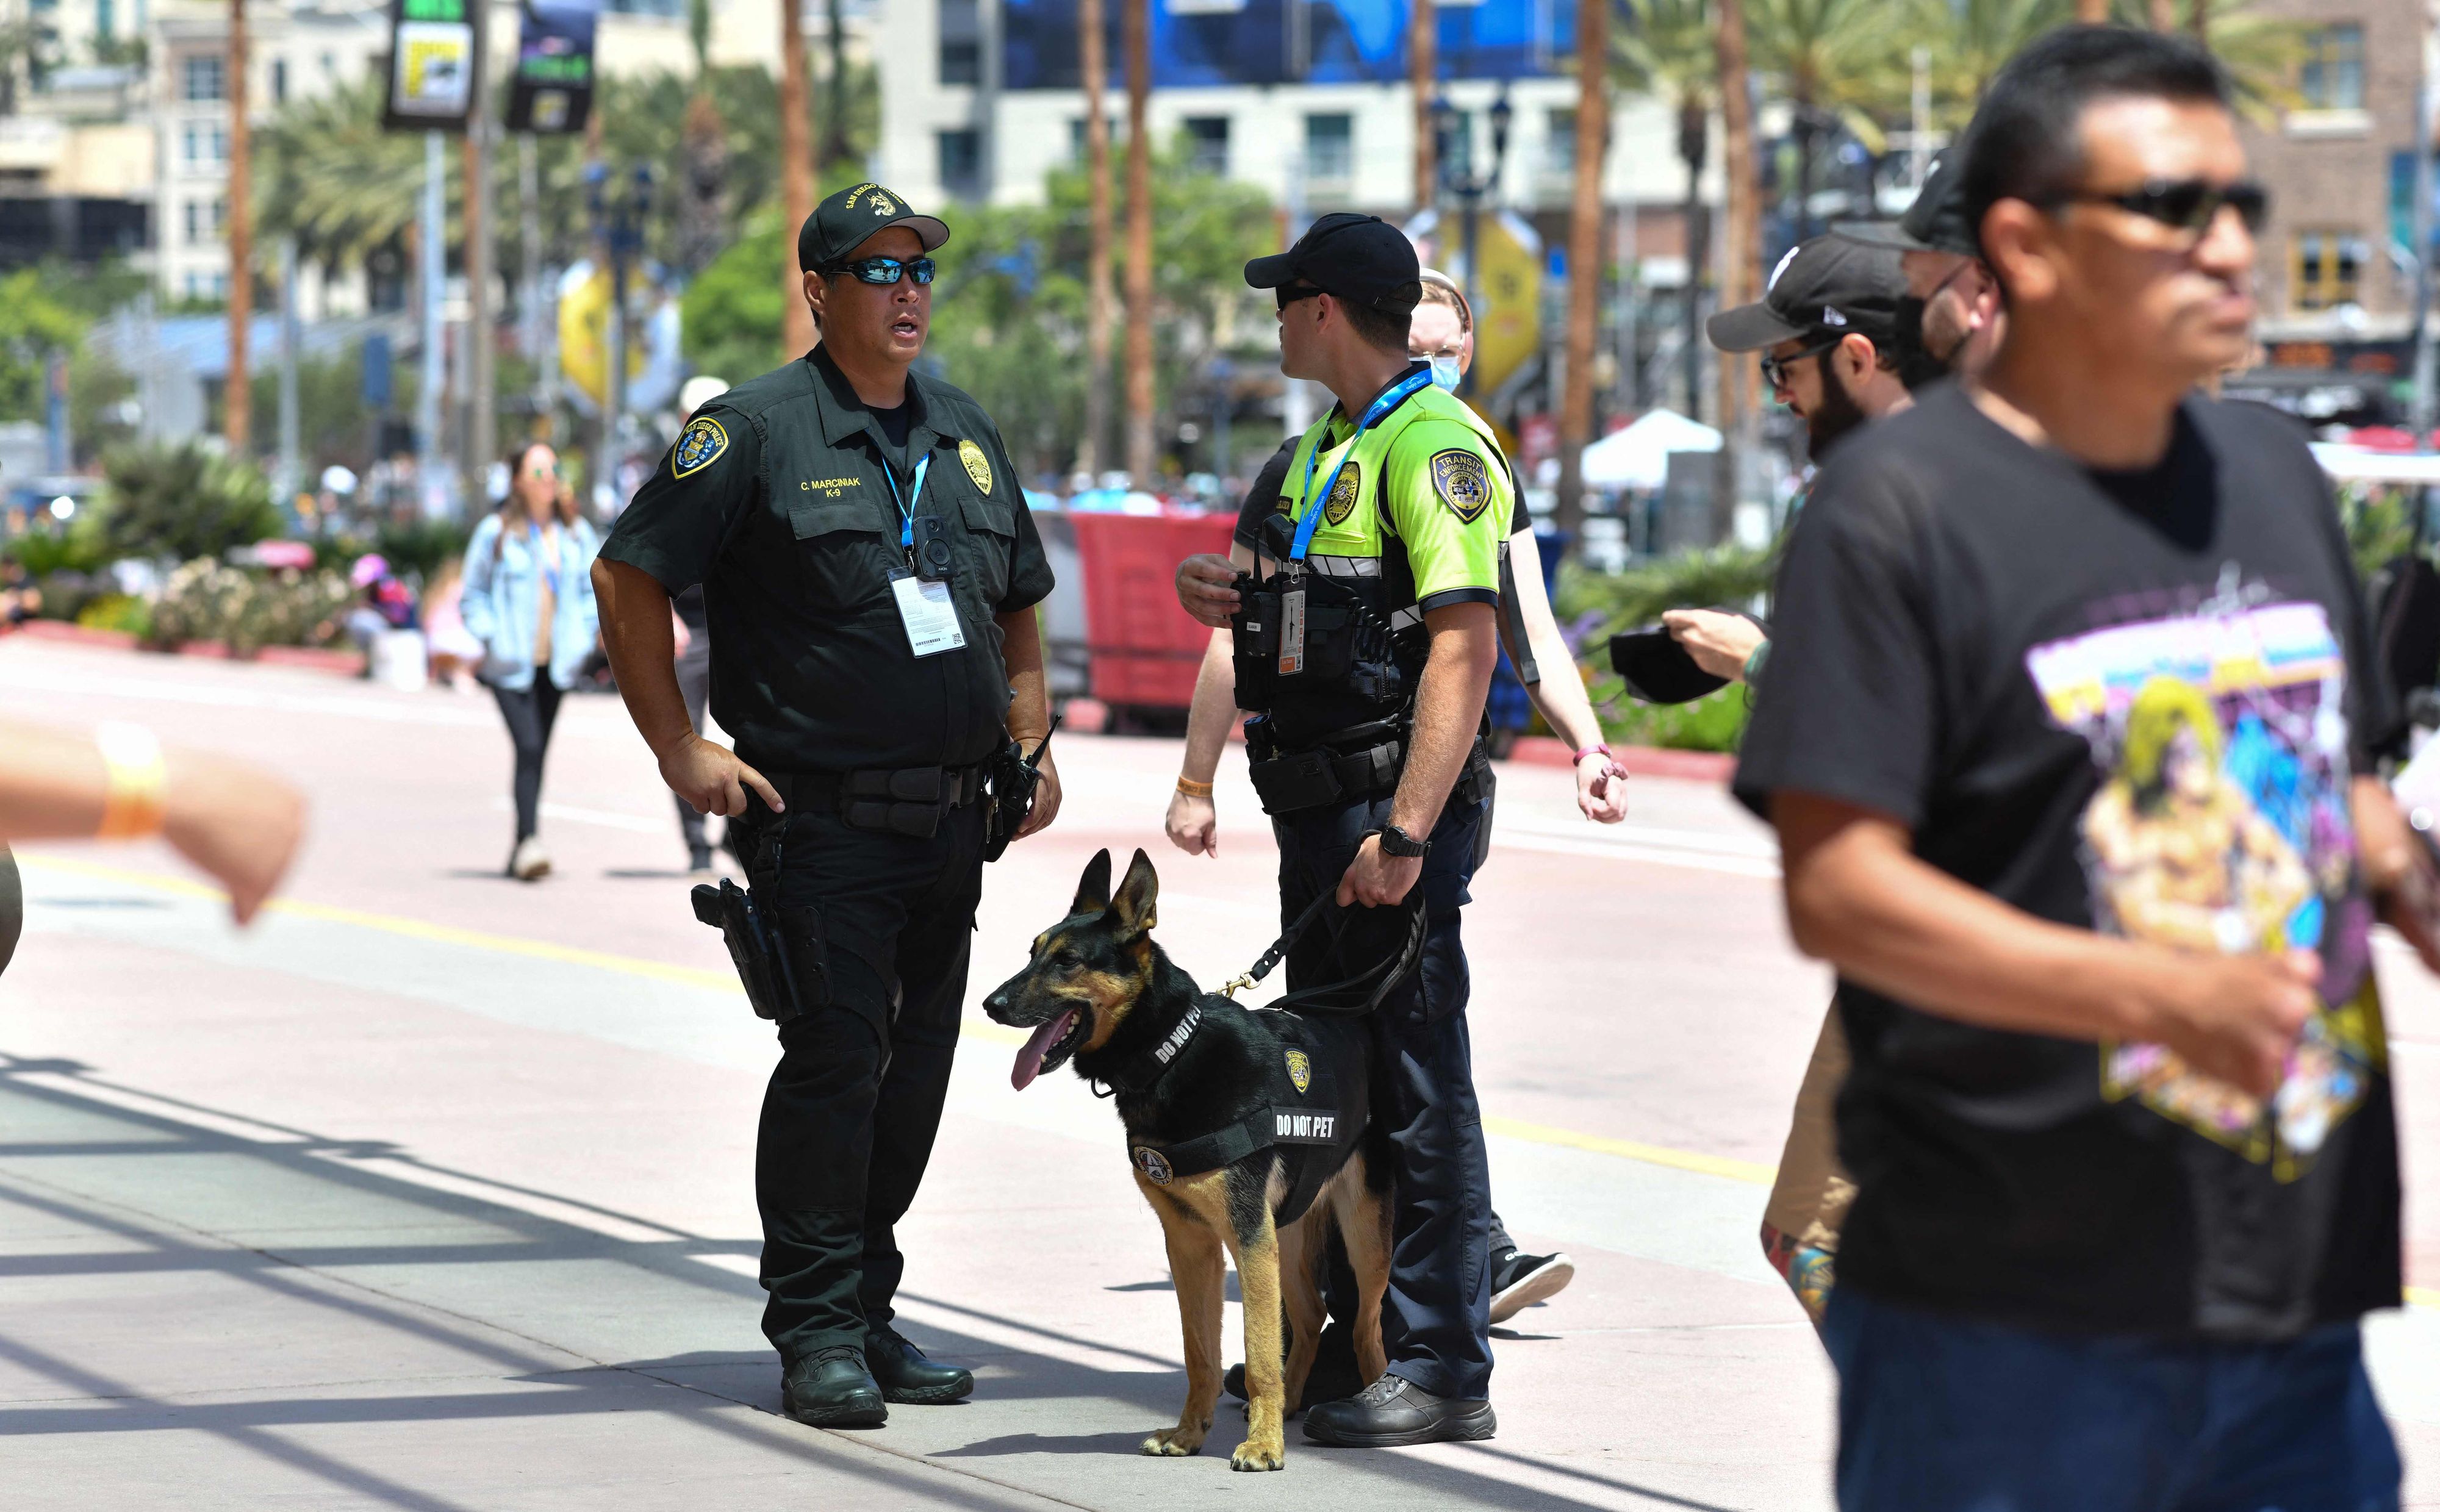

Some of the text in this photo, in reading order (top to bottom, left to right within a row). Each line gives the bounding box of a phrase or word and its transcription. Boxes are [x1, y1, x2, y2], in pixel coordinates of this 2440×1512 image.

[846, 195, 858, 209] SAN
[853, 184, 877, 196] DIEGO
[686, 422, 724, 447] SAN DIEGO POLICE
[1438, 456, 1481, 470] TRANSIT
[1439, 464, 1483, 479] ENFORCEMENT
[1449, 472, 1471, 484] METROPOLITAN
[801, 478, 861, 490] C. MARCINIAK
[826, 489, 841, 498] K-9
[1316, 496, 1325, 511] prime
[1155, 1041, 1176, 1064] DO
[1169, 1018, 1193, 1048] NOT
[1276, 1114, 1334, 1138] DO NOT PET
